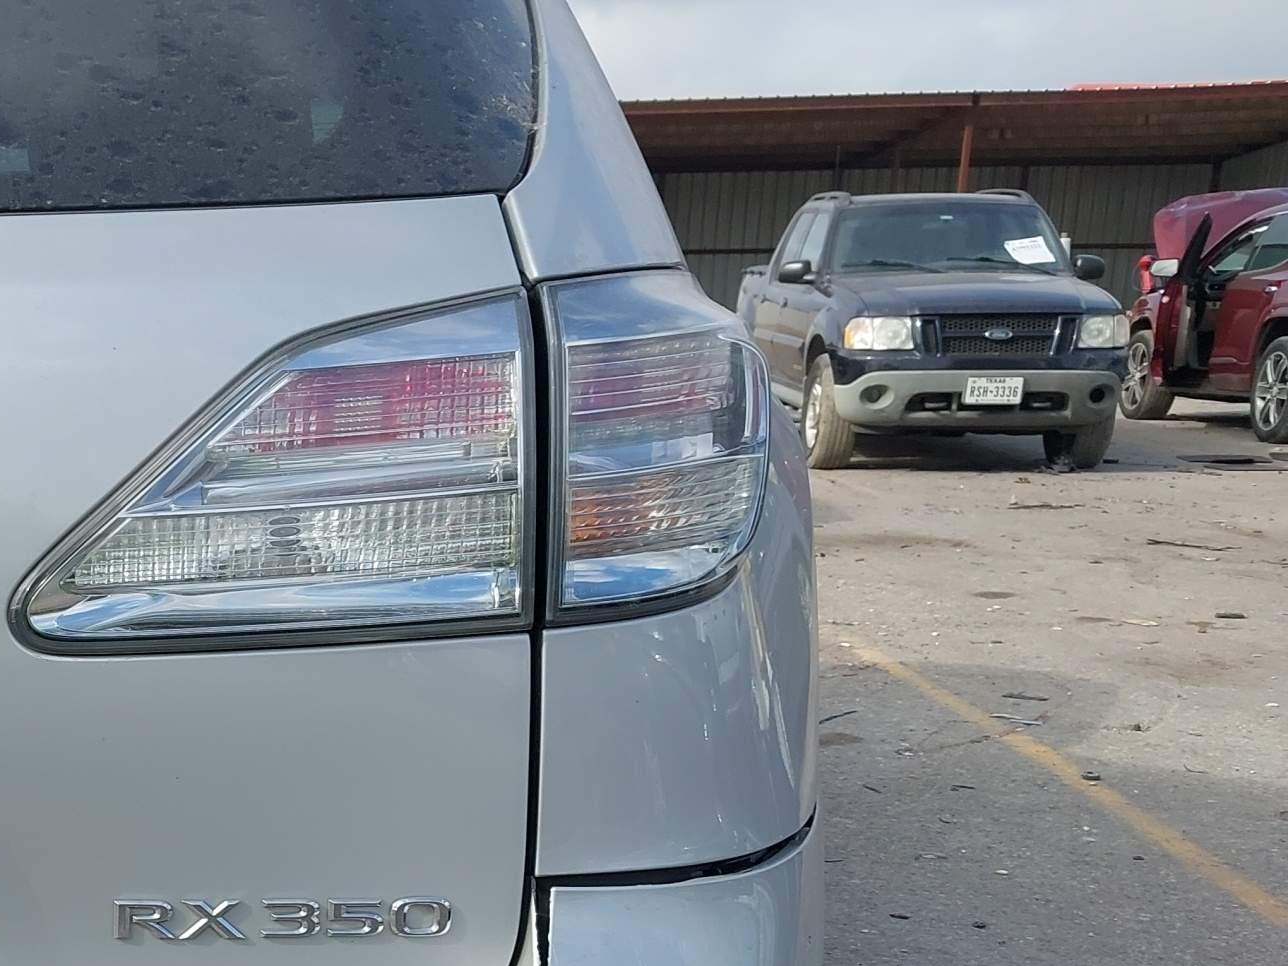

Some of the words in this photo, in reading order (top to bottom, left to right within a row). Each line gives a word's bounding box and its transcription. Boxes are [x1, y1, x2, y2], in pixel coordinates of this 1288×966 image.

[969, 385, 1019, 398] RSH-3336
[113, 899, 246, 940] RX
[258, 896, 453, 938] 350
